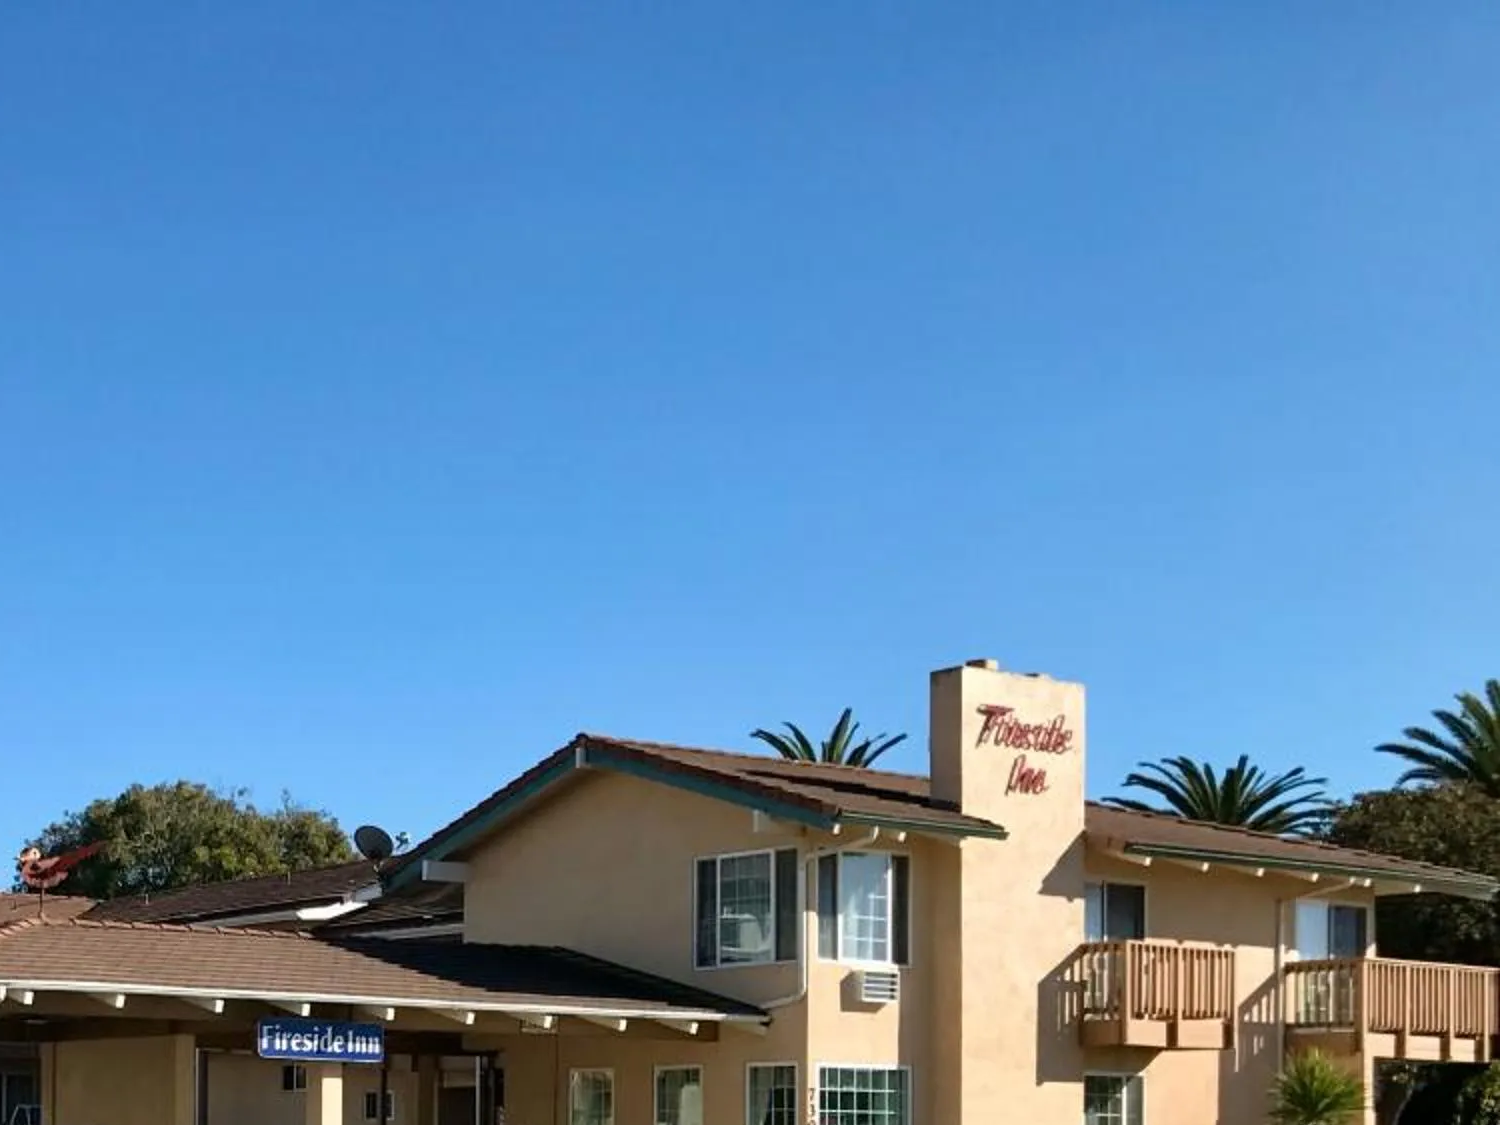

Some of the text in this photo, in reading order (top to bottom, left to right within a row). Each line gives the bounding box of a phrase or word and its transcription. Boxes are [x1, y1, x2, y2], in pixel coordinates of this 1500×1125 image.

[1004, 753, 1050, 796] Inn
[261, 1024, 380, 1054] Fireside Inn
